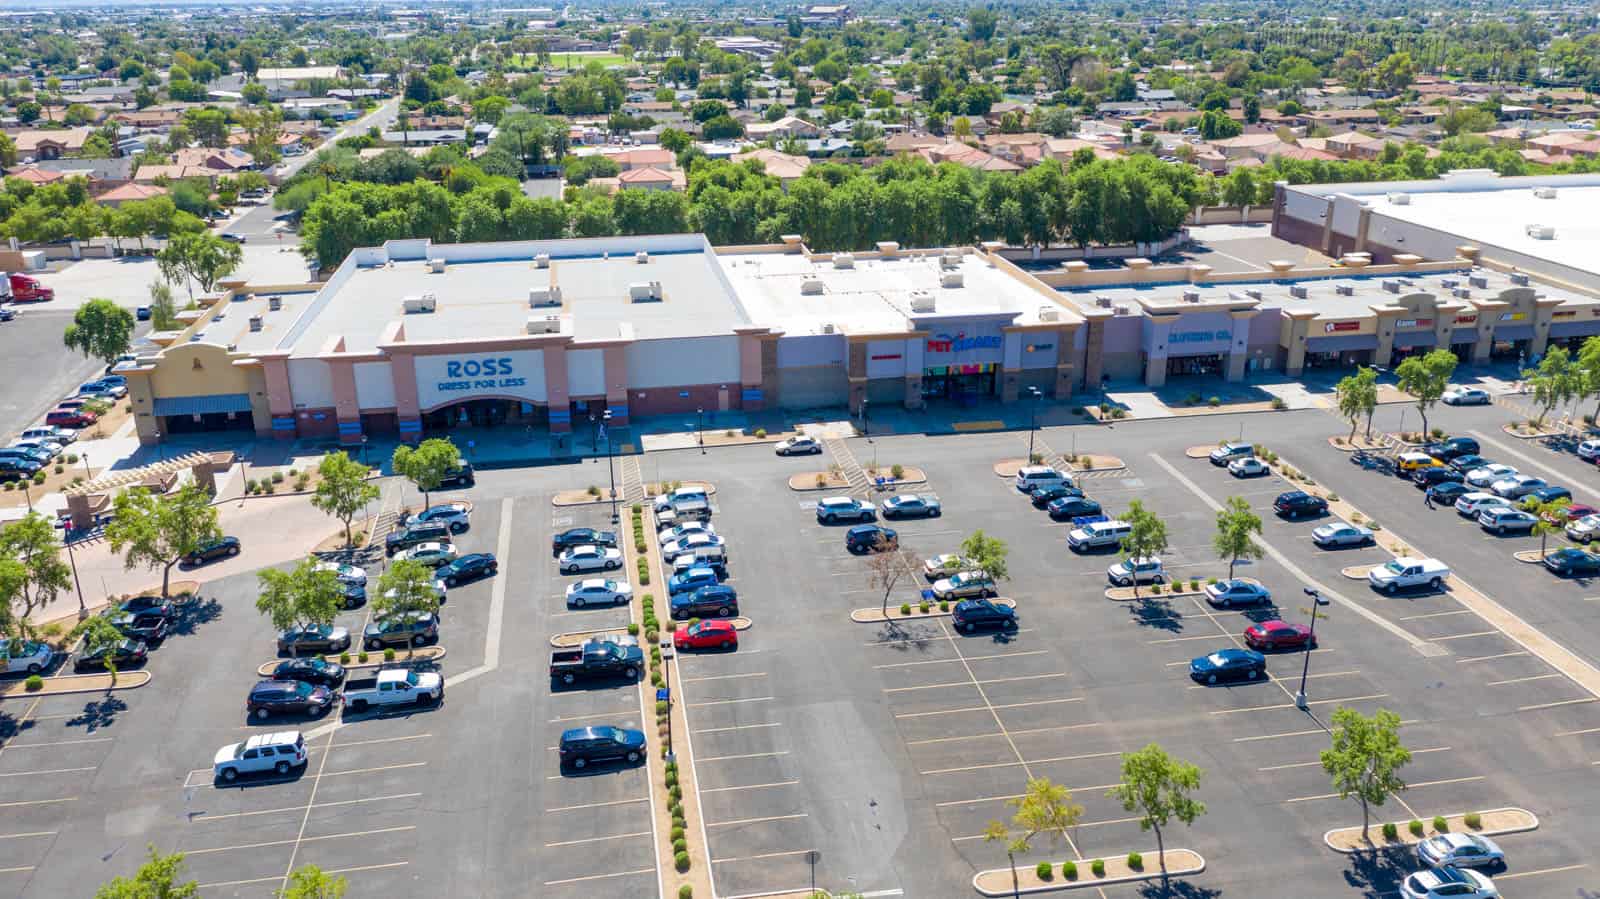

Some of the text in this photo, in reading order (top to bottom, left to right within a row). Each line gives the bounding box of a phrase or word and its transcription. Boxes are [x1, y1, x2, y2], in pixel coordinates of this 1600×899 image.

[447, 358, 513, 378] ROSS
[438, 377, 526, 391] DRESS FOR LESS
